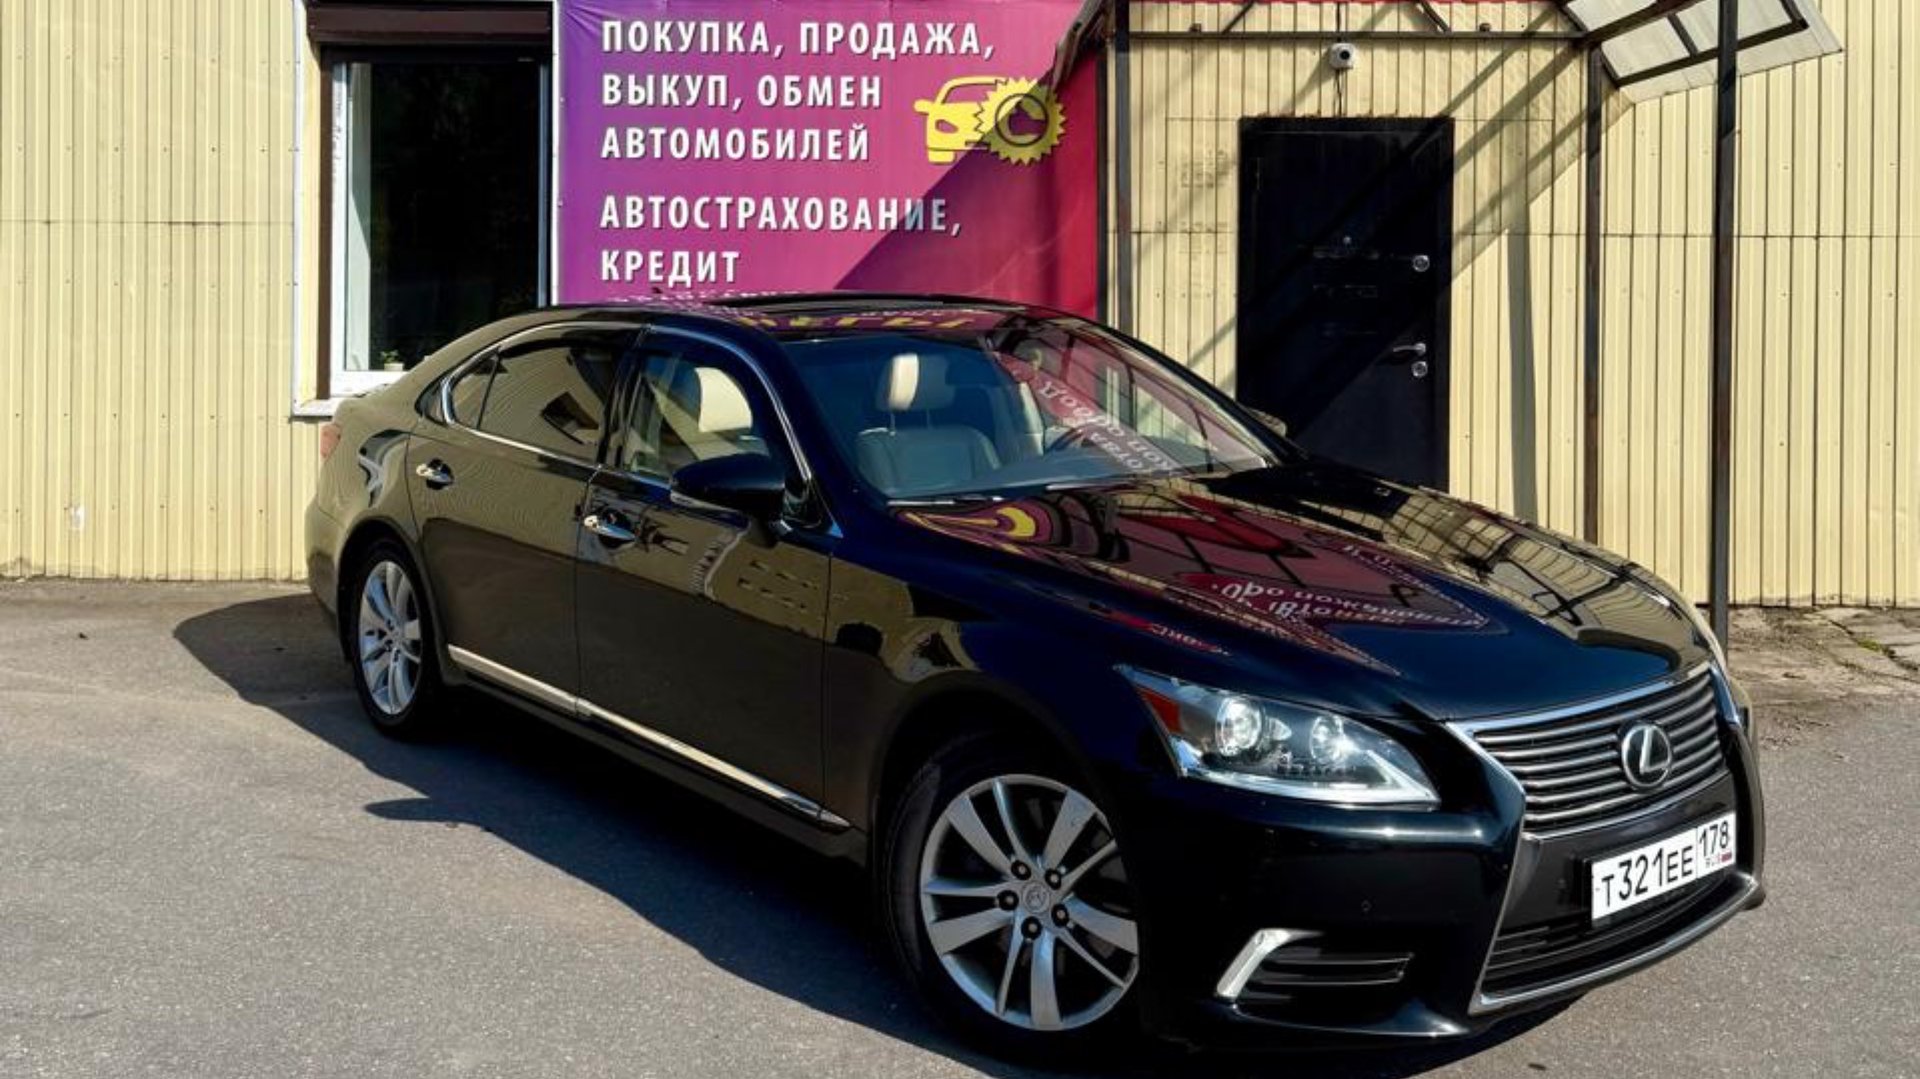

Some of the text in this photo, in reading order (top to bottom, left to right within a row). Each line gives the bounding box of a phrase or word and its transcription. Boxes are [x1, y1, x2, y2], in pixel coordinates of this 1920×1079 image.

[601, 20, 994, 60] ПОКУПКА, ПРОДАЖА,
[602, 73, 881, 112] ВЫКУП, ОБМЕН
[600, 123, 869, 161] АВТОМОБИЛЕЙ
[600, 195, 962, 236] АВТОСТРАХОВАНИЕ,
[601, 250, 740, 288] КРЕДИТ
[1601, 820, 1730, 907] Т321ЕЕ 178
